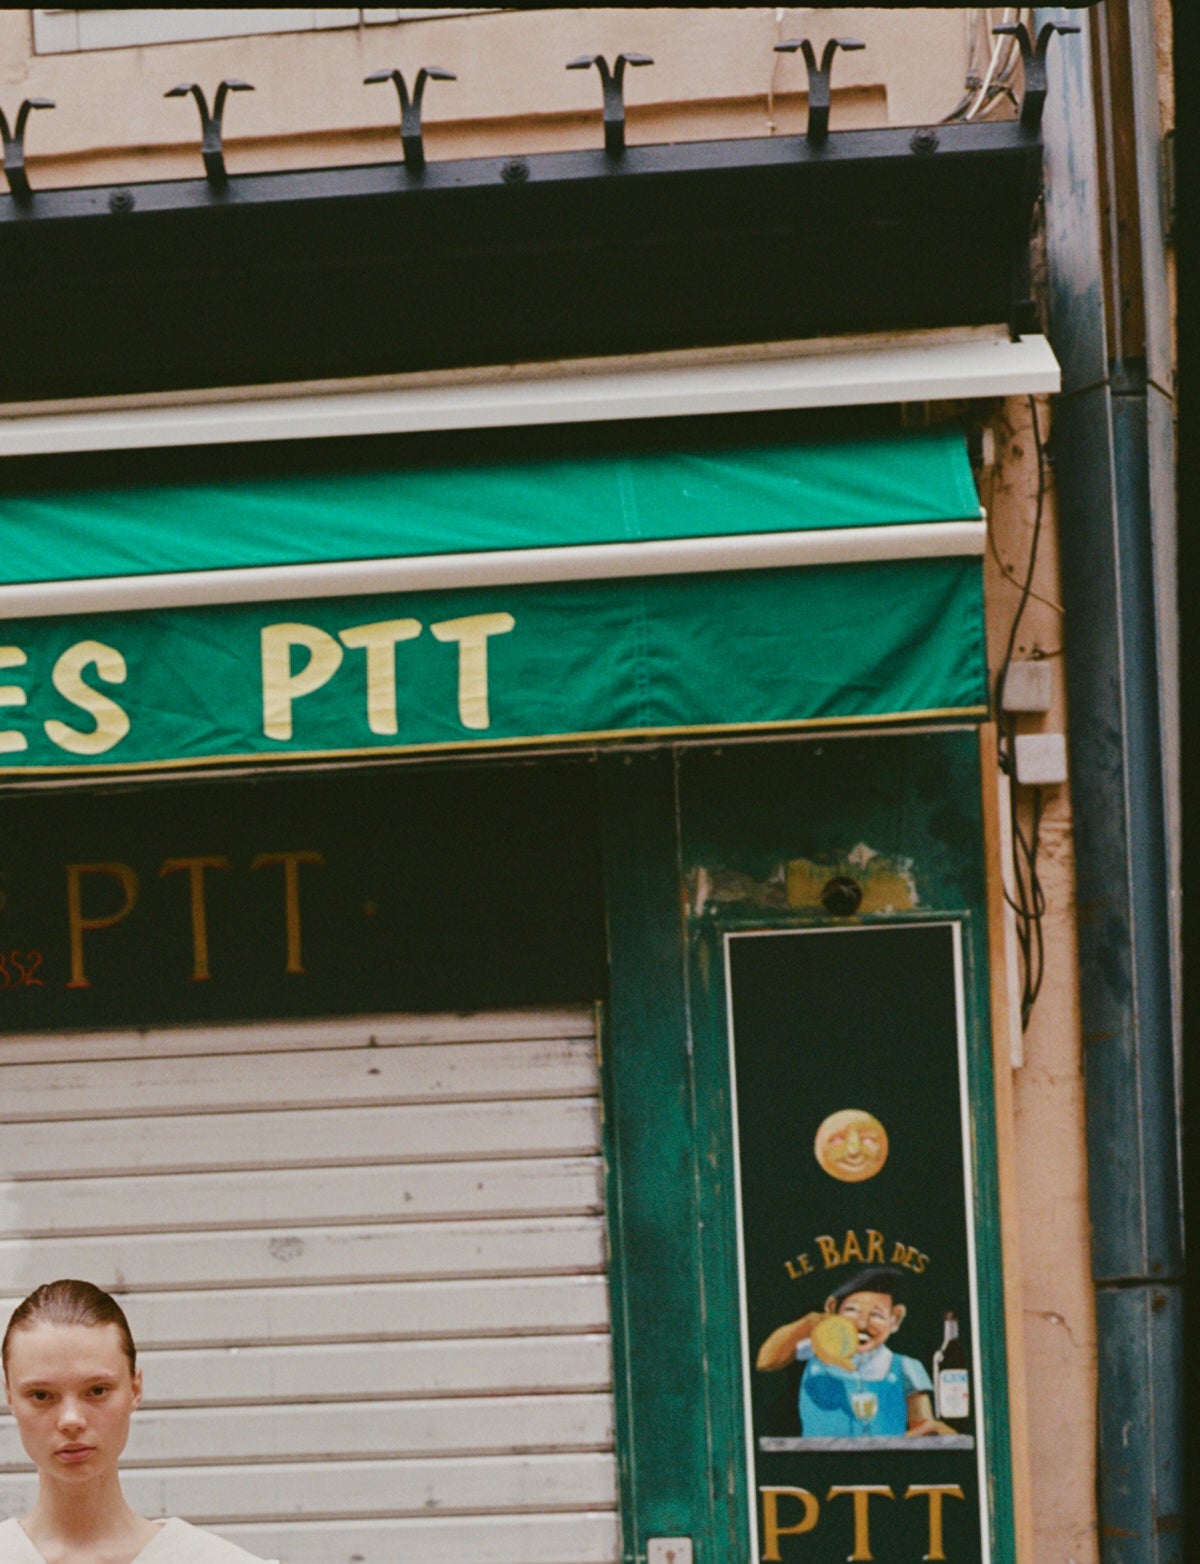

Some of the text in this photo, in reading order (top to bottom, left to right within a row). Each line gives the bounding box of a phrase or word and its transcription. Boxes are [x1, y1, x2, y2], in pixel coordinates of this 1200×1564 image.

[261, 612, 516, 740] PTT
[63, 851, 326, 990] PTT
[784, 1228, 930, 1280] LE BAR DES
[759, 1484, 966, 1562] PTT
